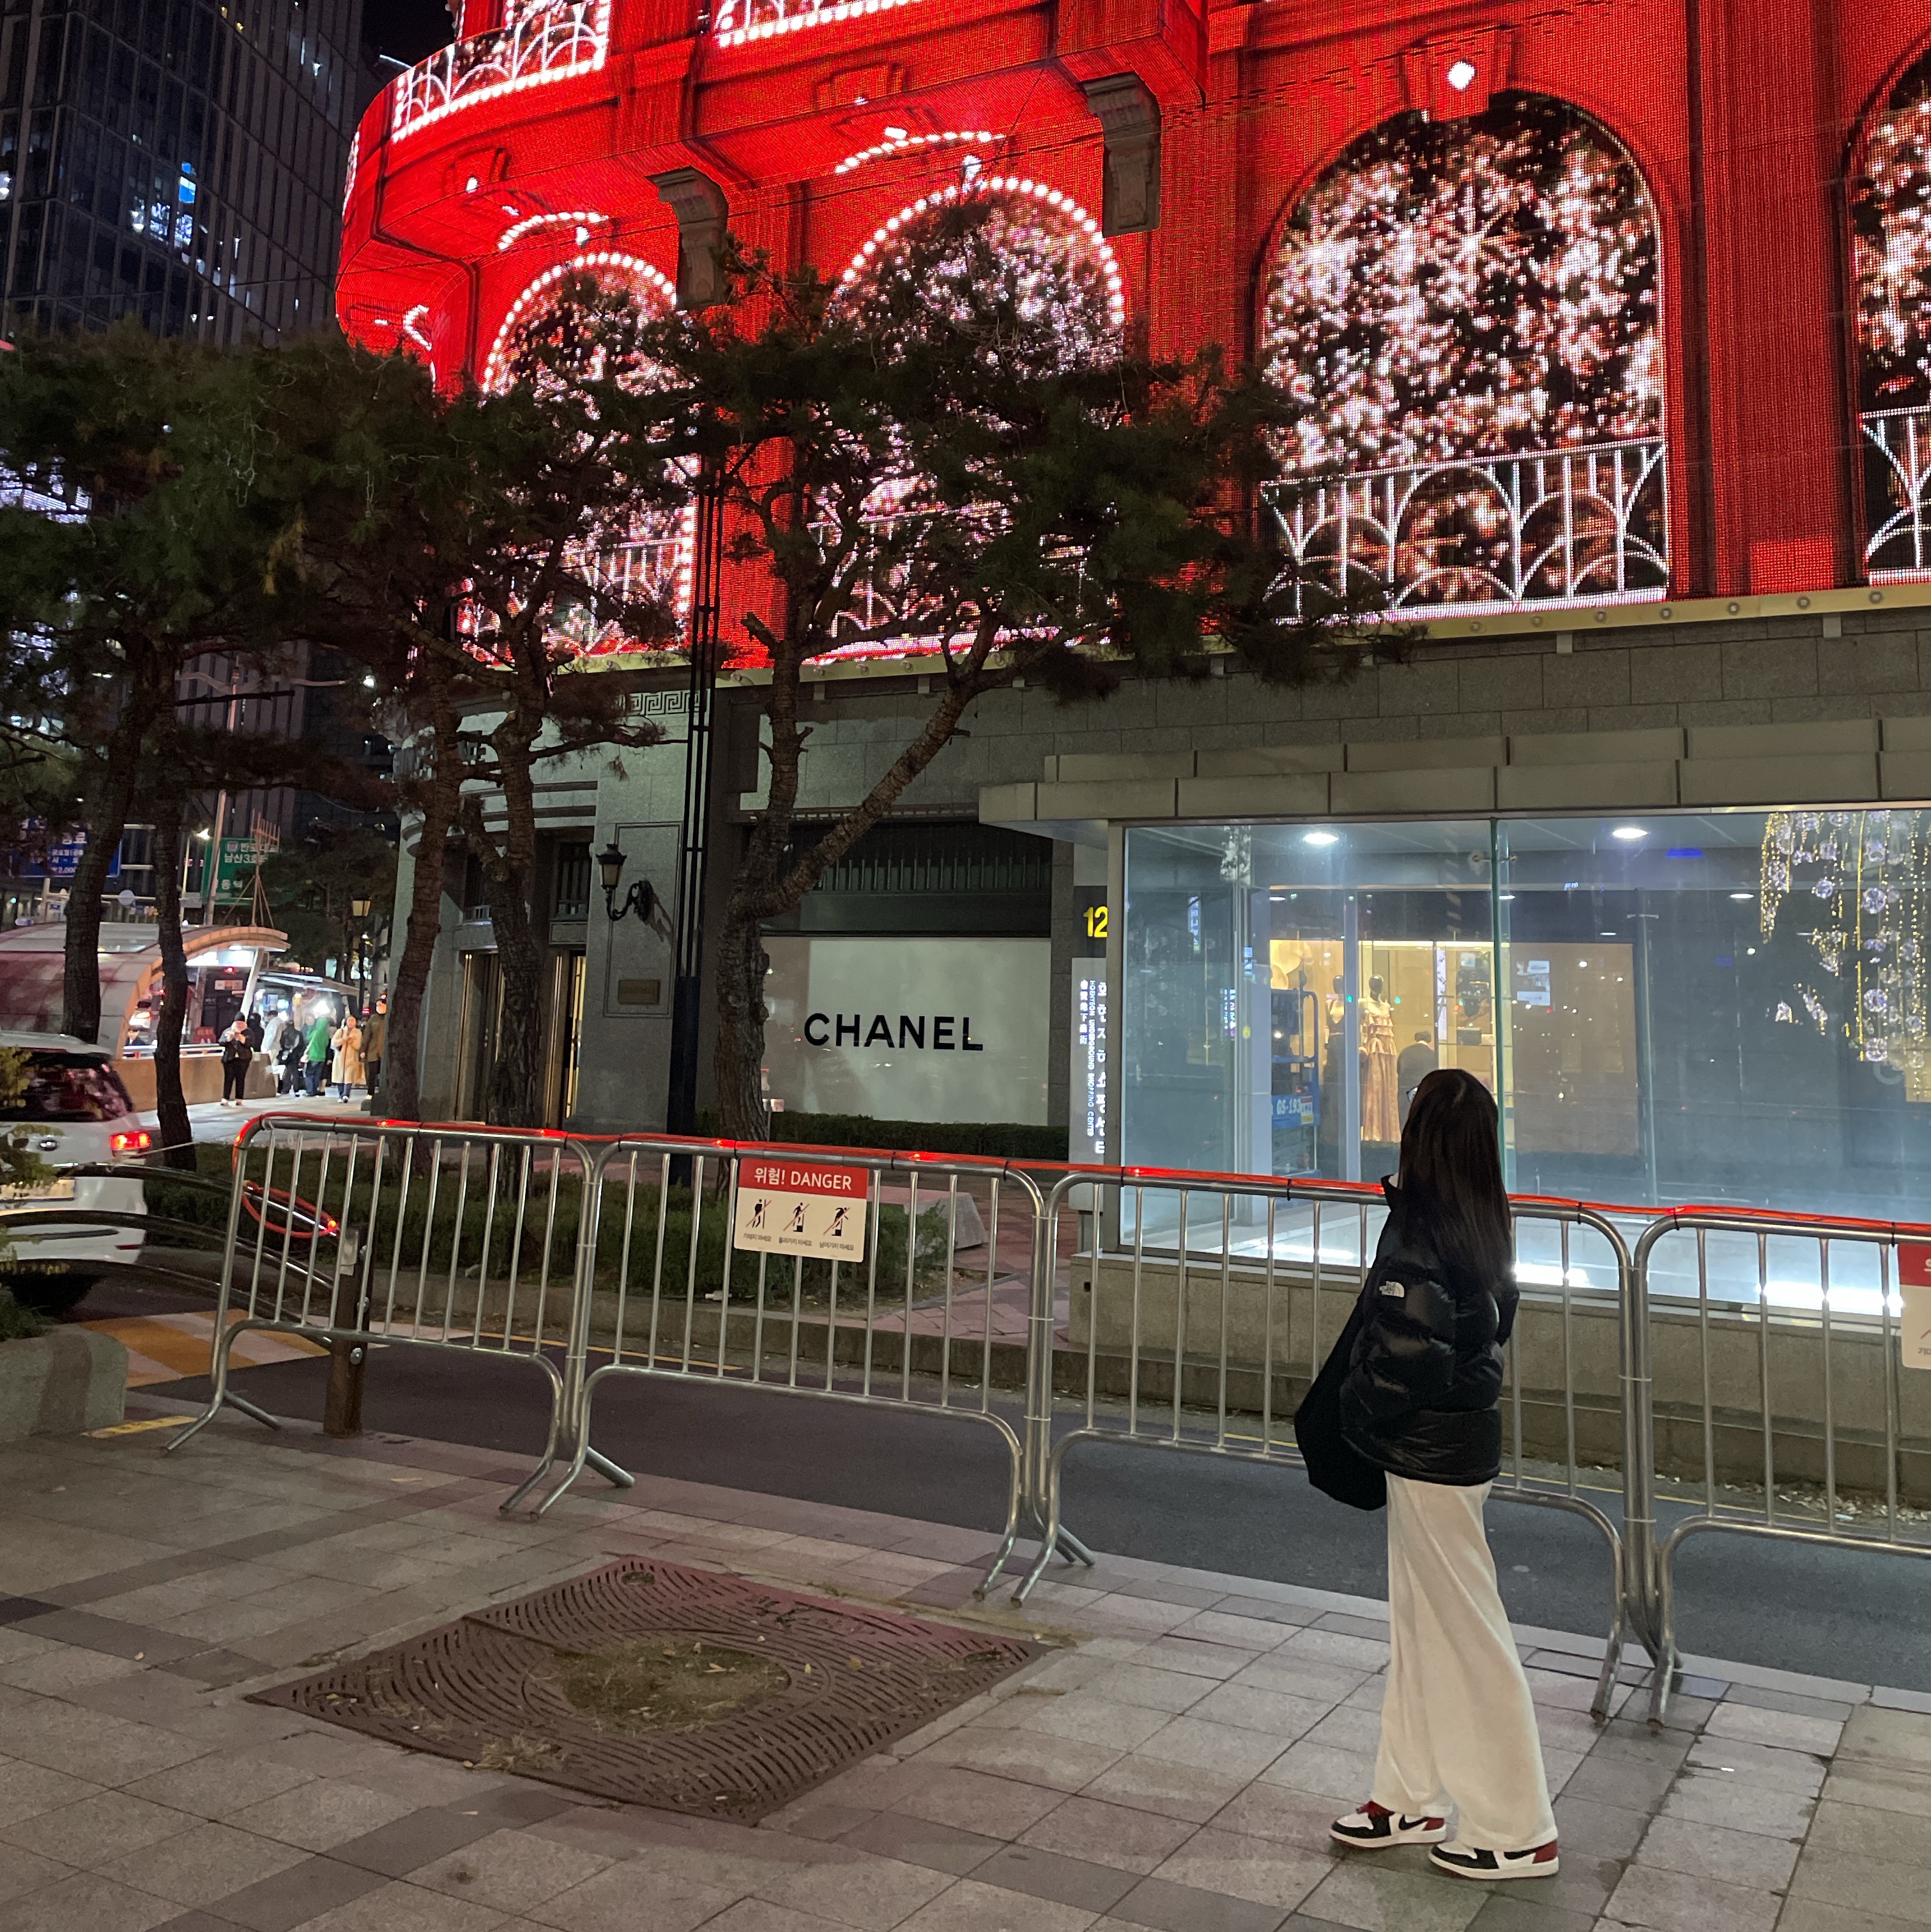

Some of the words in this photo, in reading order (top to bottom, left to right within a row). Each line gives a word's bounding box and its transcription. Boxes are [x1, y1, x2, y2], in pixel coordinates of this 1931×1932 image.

[1083, 906, 1109, 938] 12
[804, 1012, 984, 1051] CHANEL
[1087, 1072, 1095, 1108] SHOPPING
[754, 1167, 786, 1186] 위험!
[790, 1171, 852, 1190] DANGER
